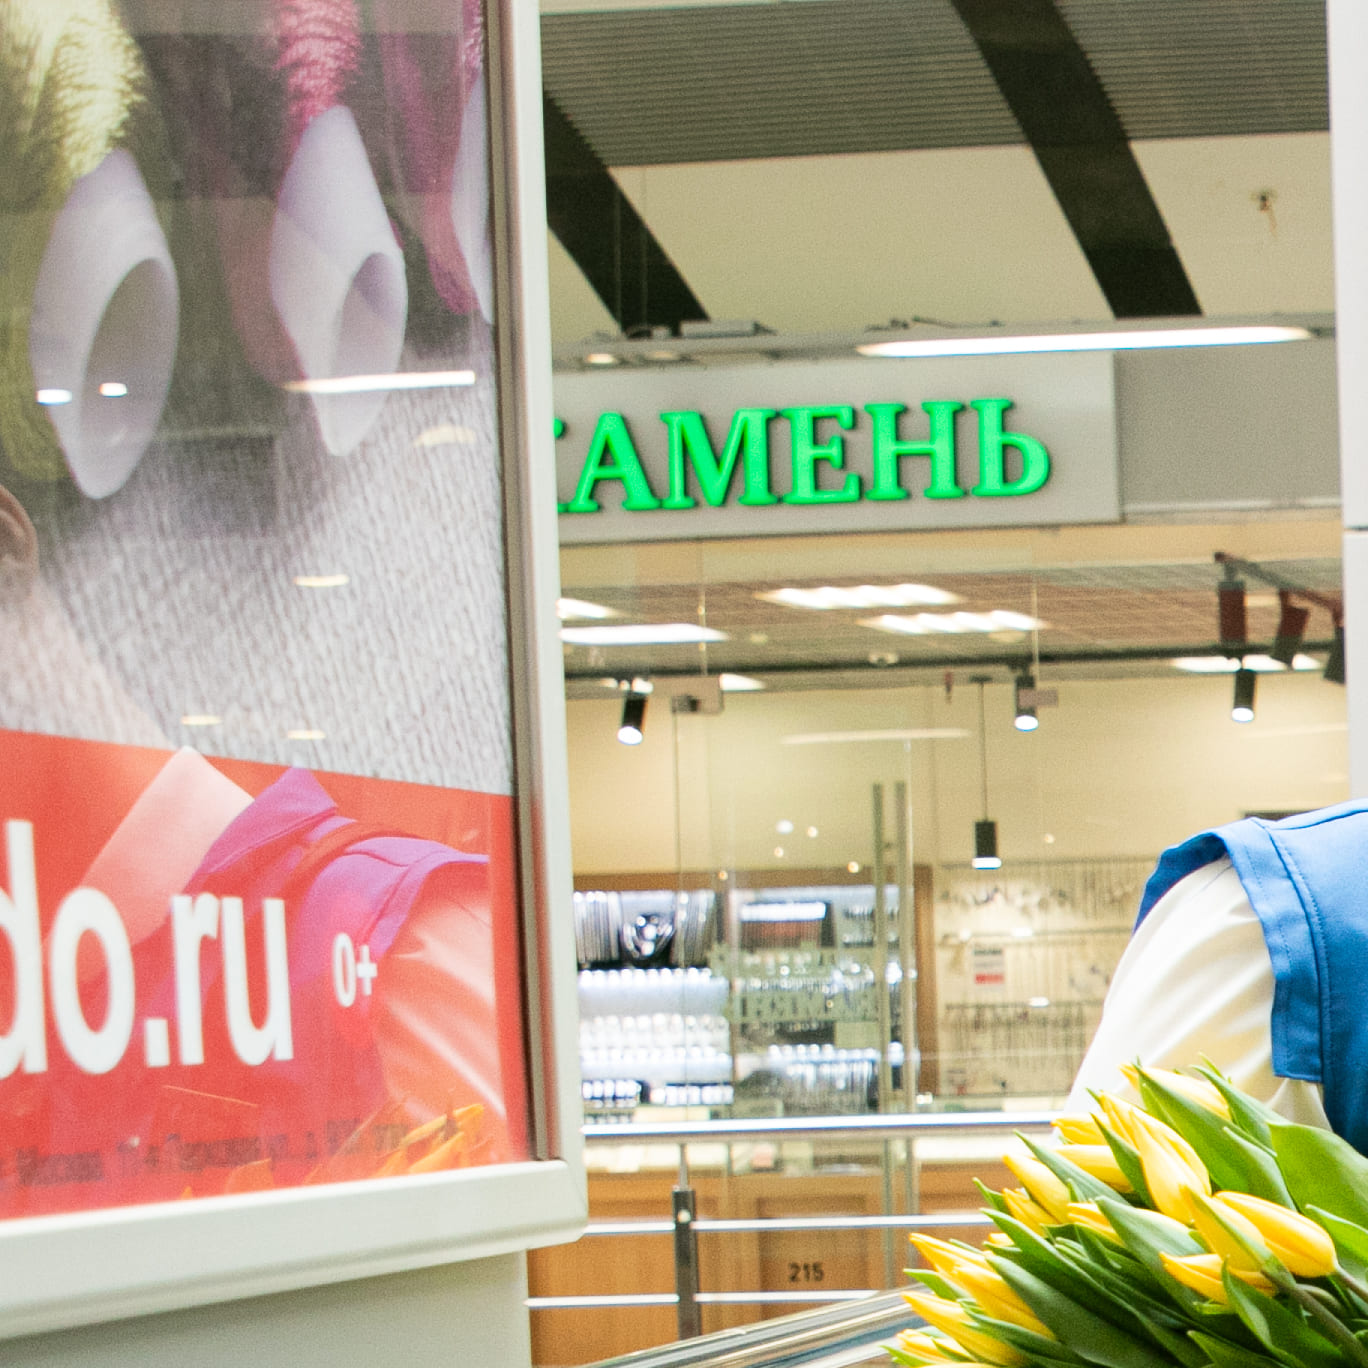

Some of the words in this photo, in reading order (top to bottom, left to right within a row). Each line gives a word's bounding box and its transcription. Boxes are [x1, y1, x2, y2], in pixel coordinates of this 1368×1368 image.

[556, 399, 1050, 512] АМЕНЬ
[332, 932, 377, 1006] 0+
[788, 1262, 825, 1282] 215
